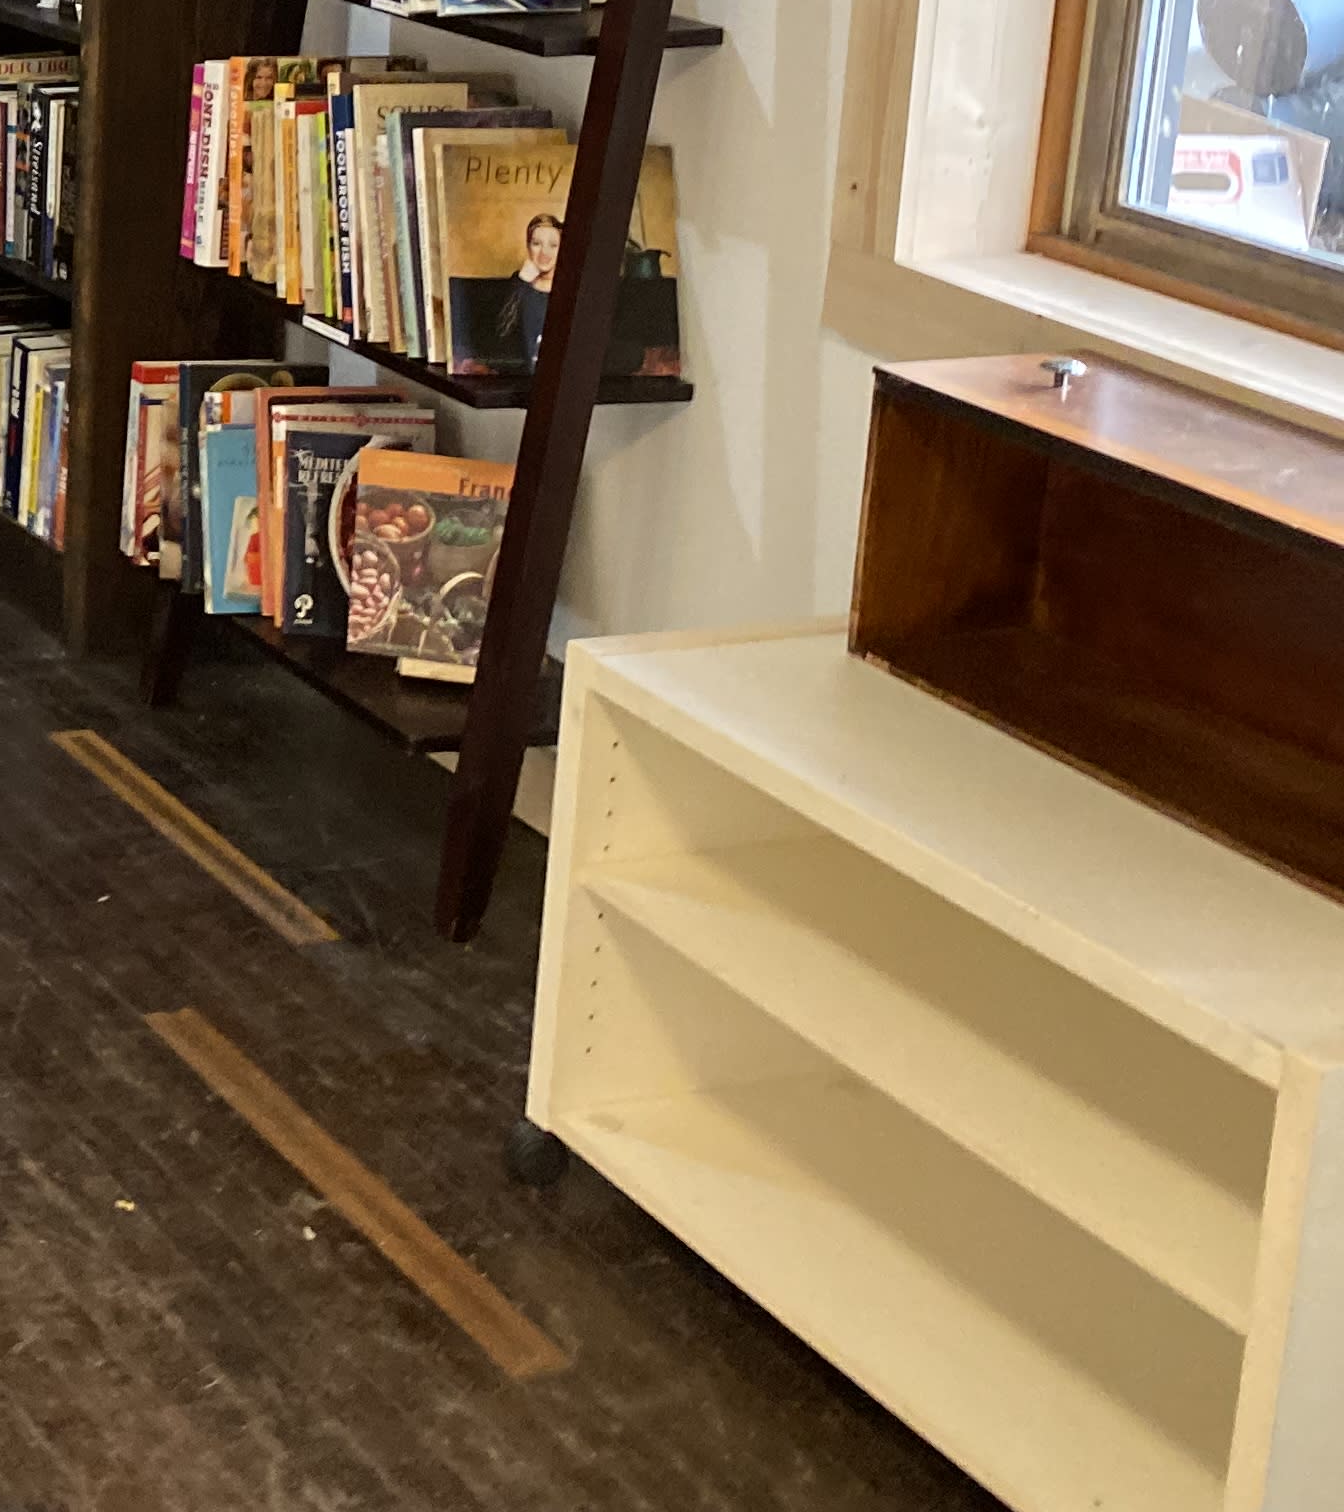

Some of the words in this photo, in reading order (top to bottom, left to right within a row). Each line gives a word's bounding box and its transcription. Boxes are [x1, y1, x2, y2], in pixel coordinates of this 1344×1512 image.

[198, 90, 214, 178] ONE-DISH
[229, 84, 241, 159] favorites
[30, 137, 44, 216] Streisand
[335, 130, 350, 232] FOOLPROOF
[464, 155, 563, 194] Plenty
[340, 236, 351, 274] FISH
[459, 477, 515, 501] Fran
